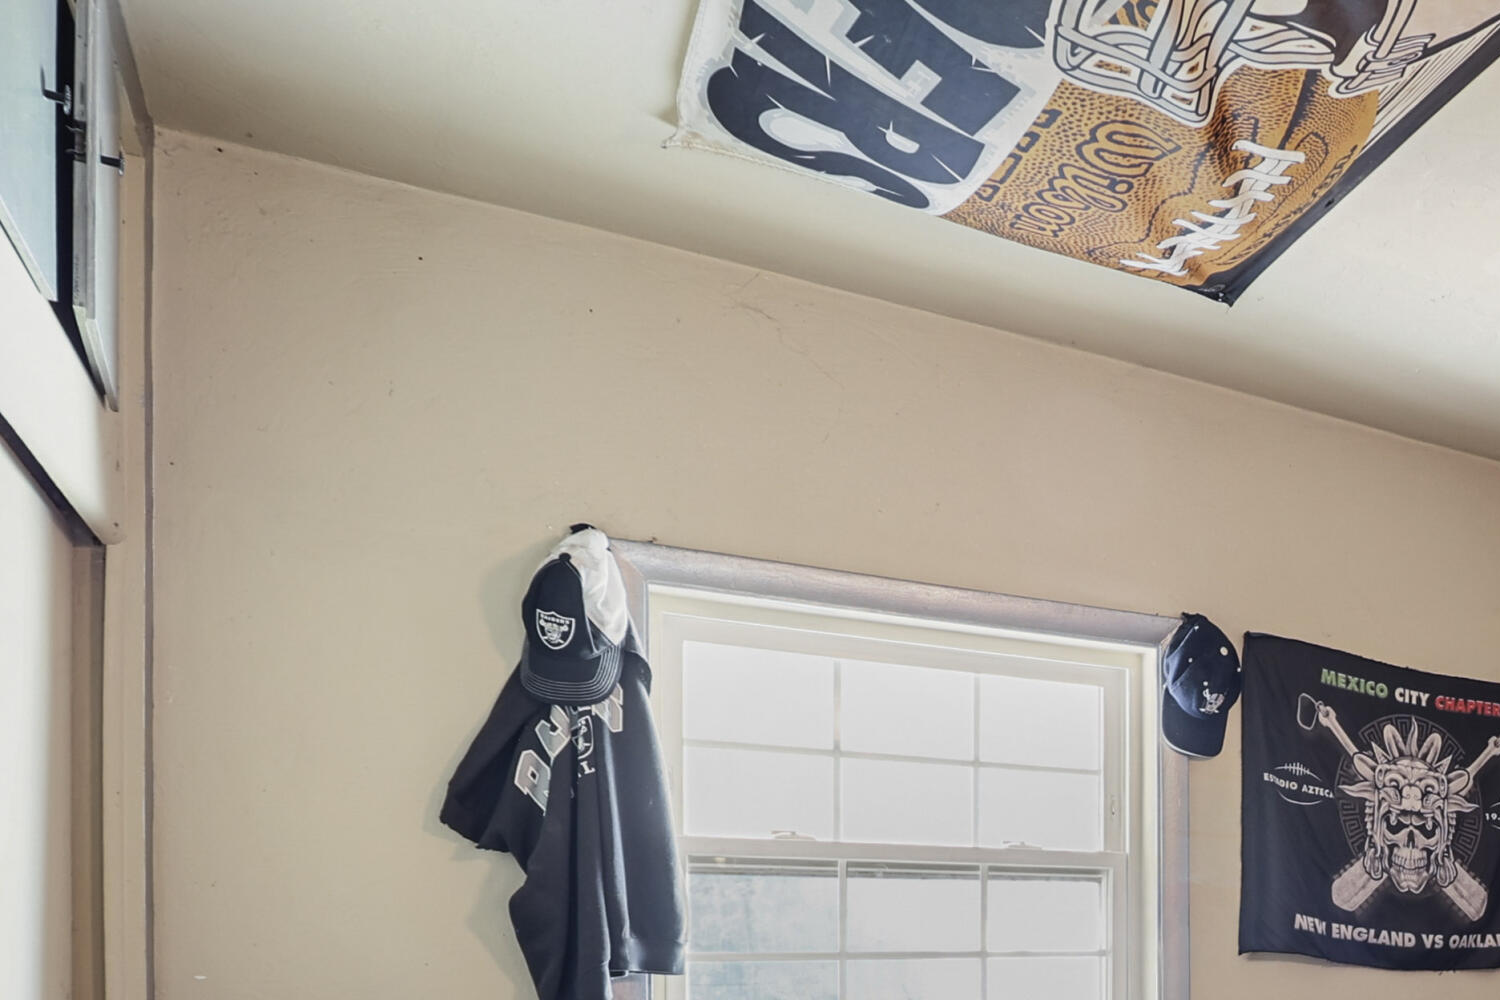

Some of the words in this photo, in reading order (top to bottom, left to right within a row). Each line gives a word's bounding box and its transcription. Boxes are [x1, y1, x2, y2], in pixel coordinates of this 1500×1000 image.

[1012, 119, 1182, 238] Wilson
[1320, 668, 1389, 699] MEXICO
[1394, 687, 1430, 707] CITY
[1294, 913, 1327, 936] NEW
[1331, 922, 1416, 948] ENGLAND
[1421, 933, 1444, 949] VS
